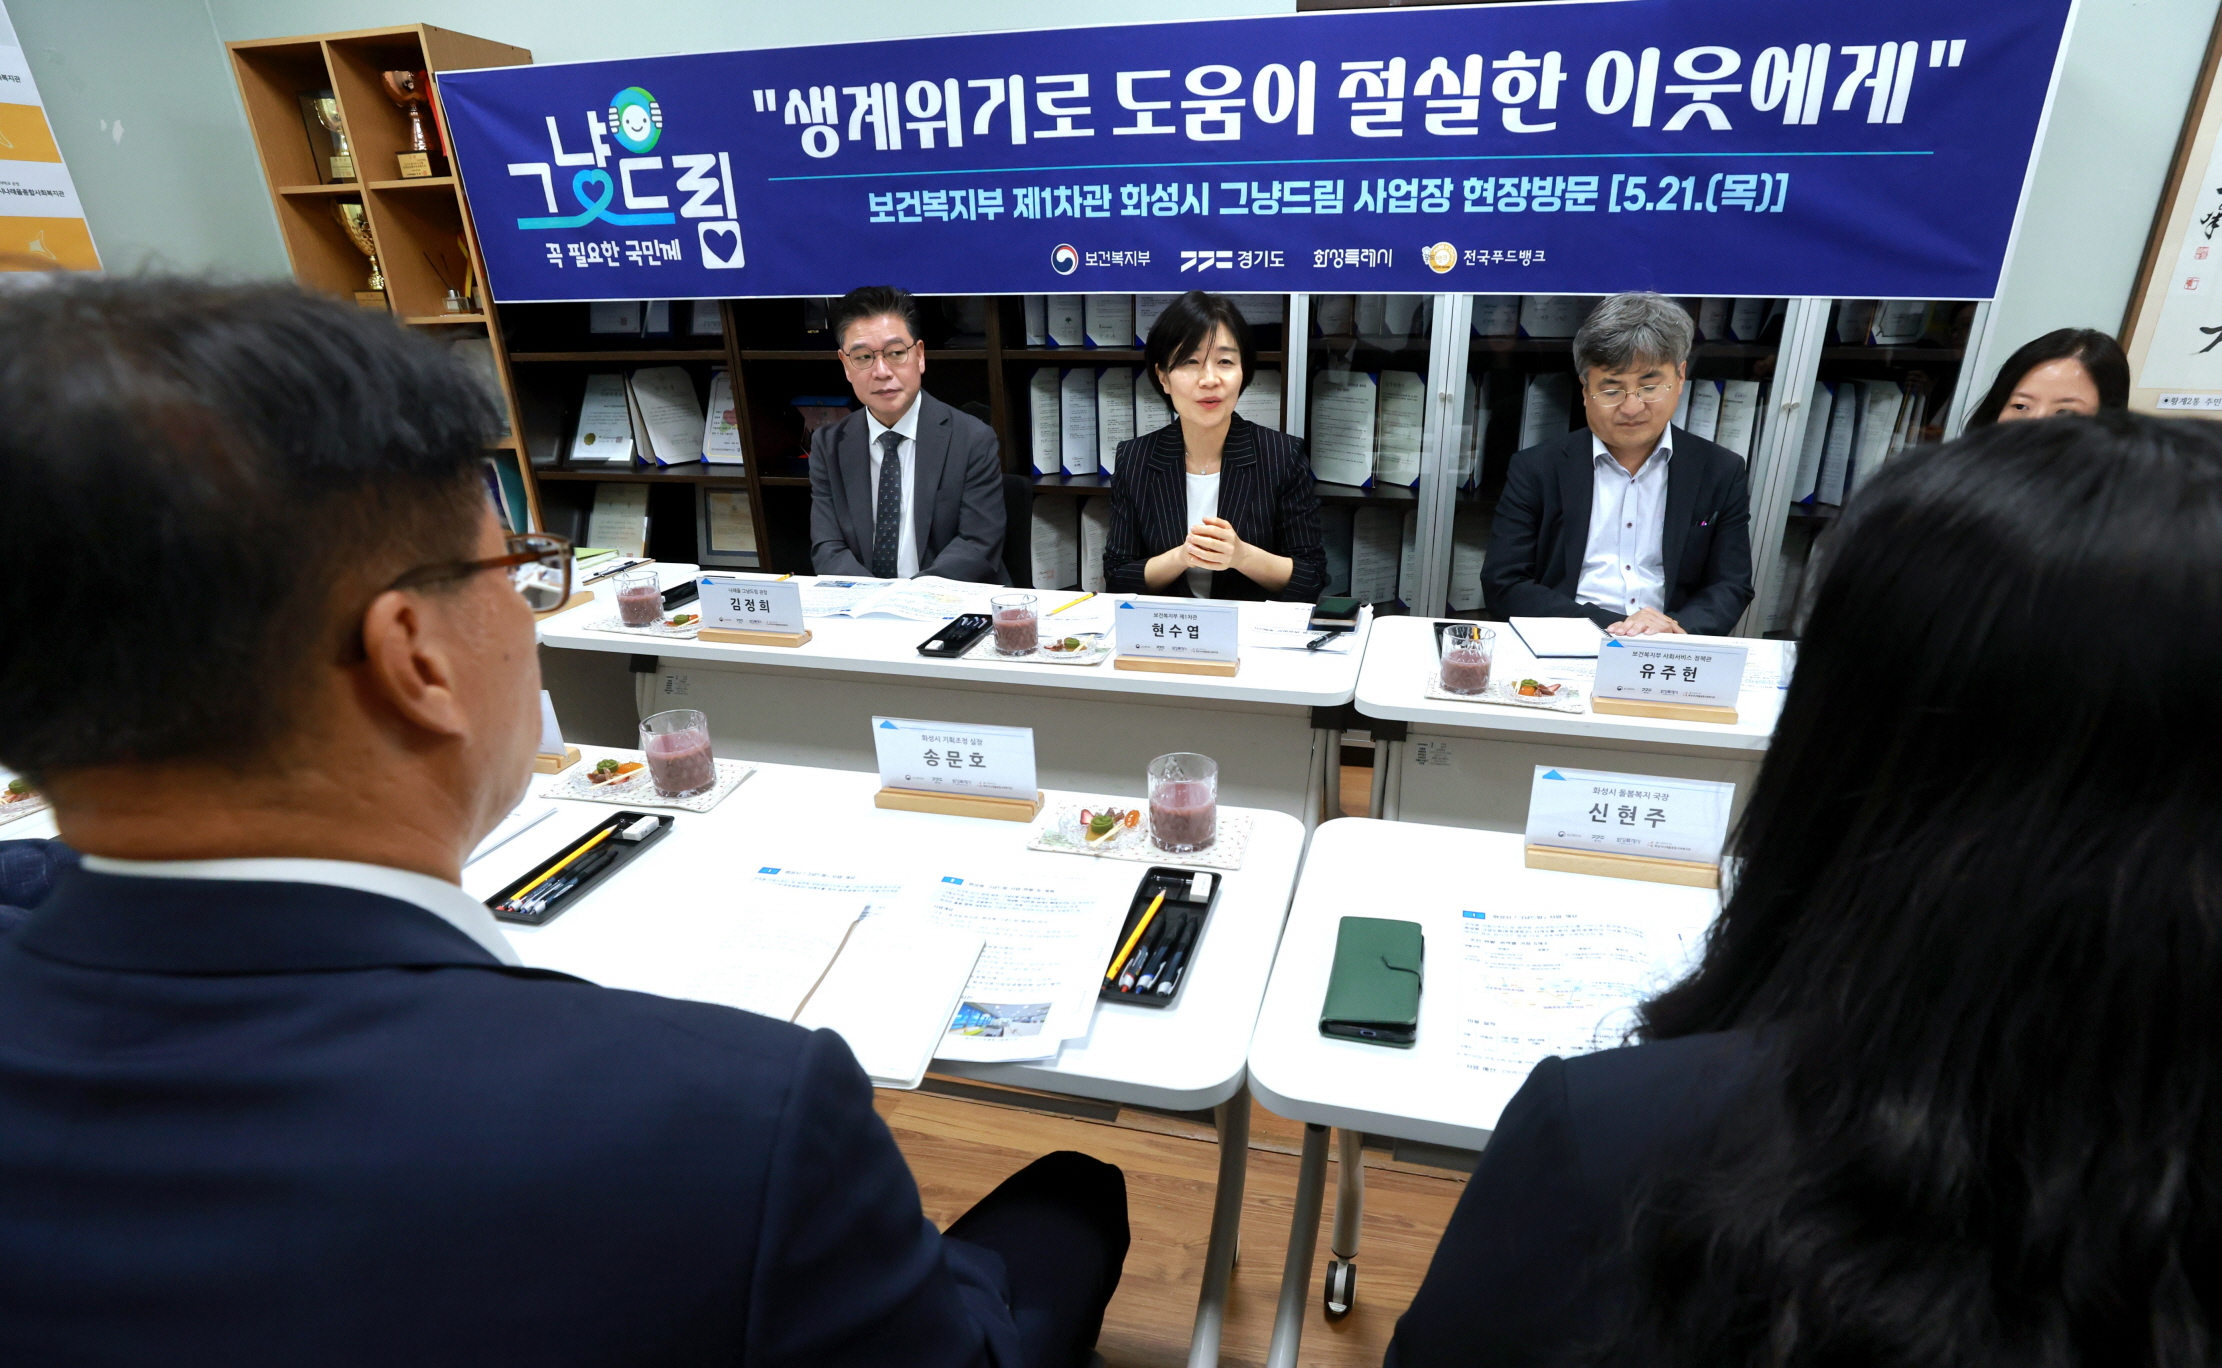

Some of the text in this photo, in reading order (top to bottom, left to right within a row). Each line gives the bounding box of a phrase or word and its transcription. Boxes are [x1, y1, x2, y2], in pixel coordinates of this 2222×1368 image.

[0, 74, 22, 83] 복지관
[753, 40, 1966, 158] "생계위기로 도움이 절실한 이웃에게"
[869, 172, 1790, 222] 보건복지부 제1차관 화성시 그냥드림 사업장 현장방문 [5.21.(목)]
[545, 242, 564, 269] 꼭
[567, 240, 620, 268] 필요한
[1085, 248, 1393, 268] 보건복지부 경기도 화성특례시
[1463, 249, 1546, 267] 전국푸드뱅크
[730, 597, 770, 613] 김정희
[1151, 623, 1199, 640] 현수엽
[1632, 651, 1662, 659] 보건복지부
[1639, 663, 1698, 683] 유주헌
[921, 734, 941, 743] 화성시
[969, 738, 984, 746] 실장
[922, 748, 987, 769] 송문호
[1592, 786, 1670, 802] 화성시 돌봄복지 국장
[1588, 802, 1667, 829] 신현주
